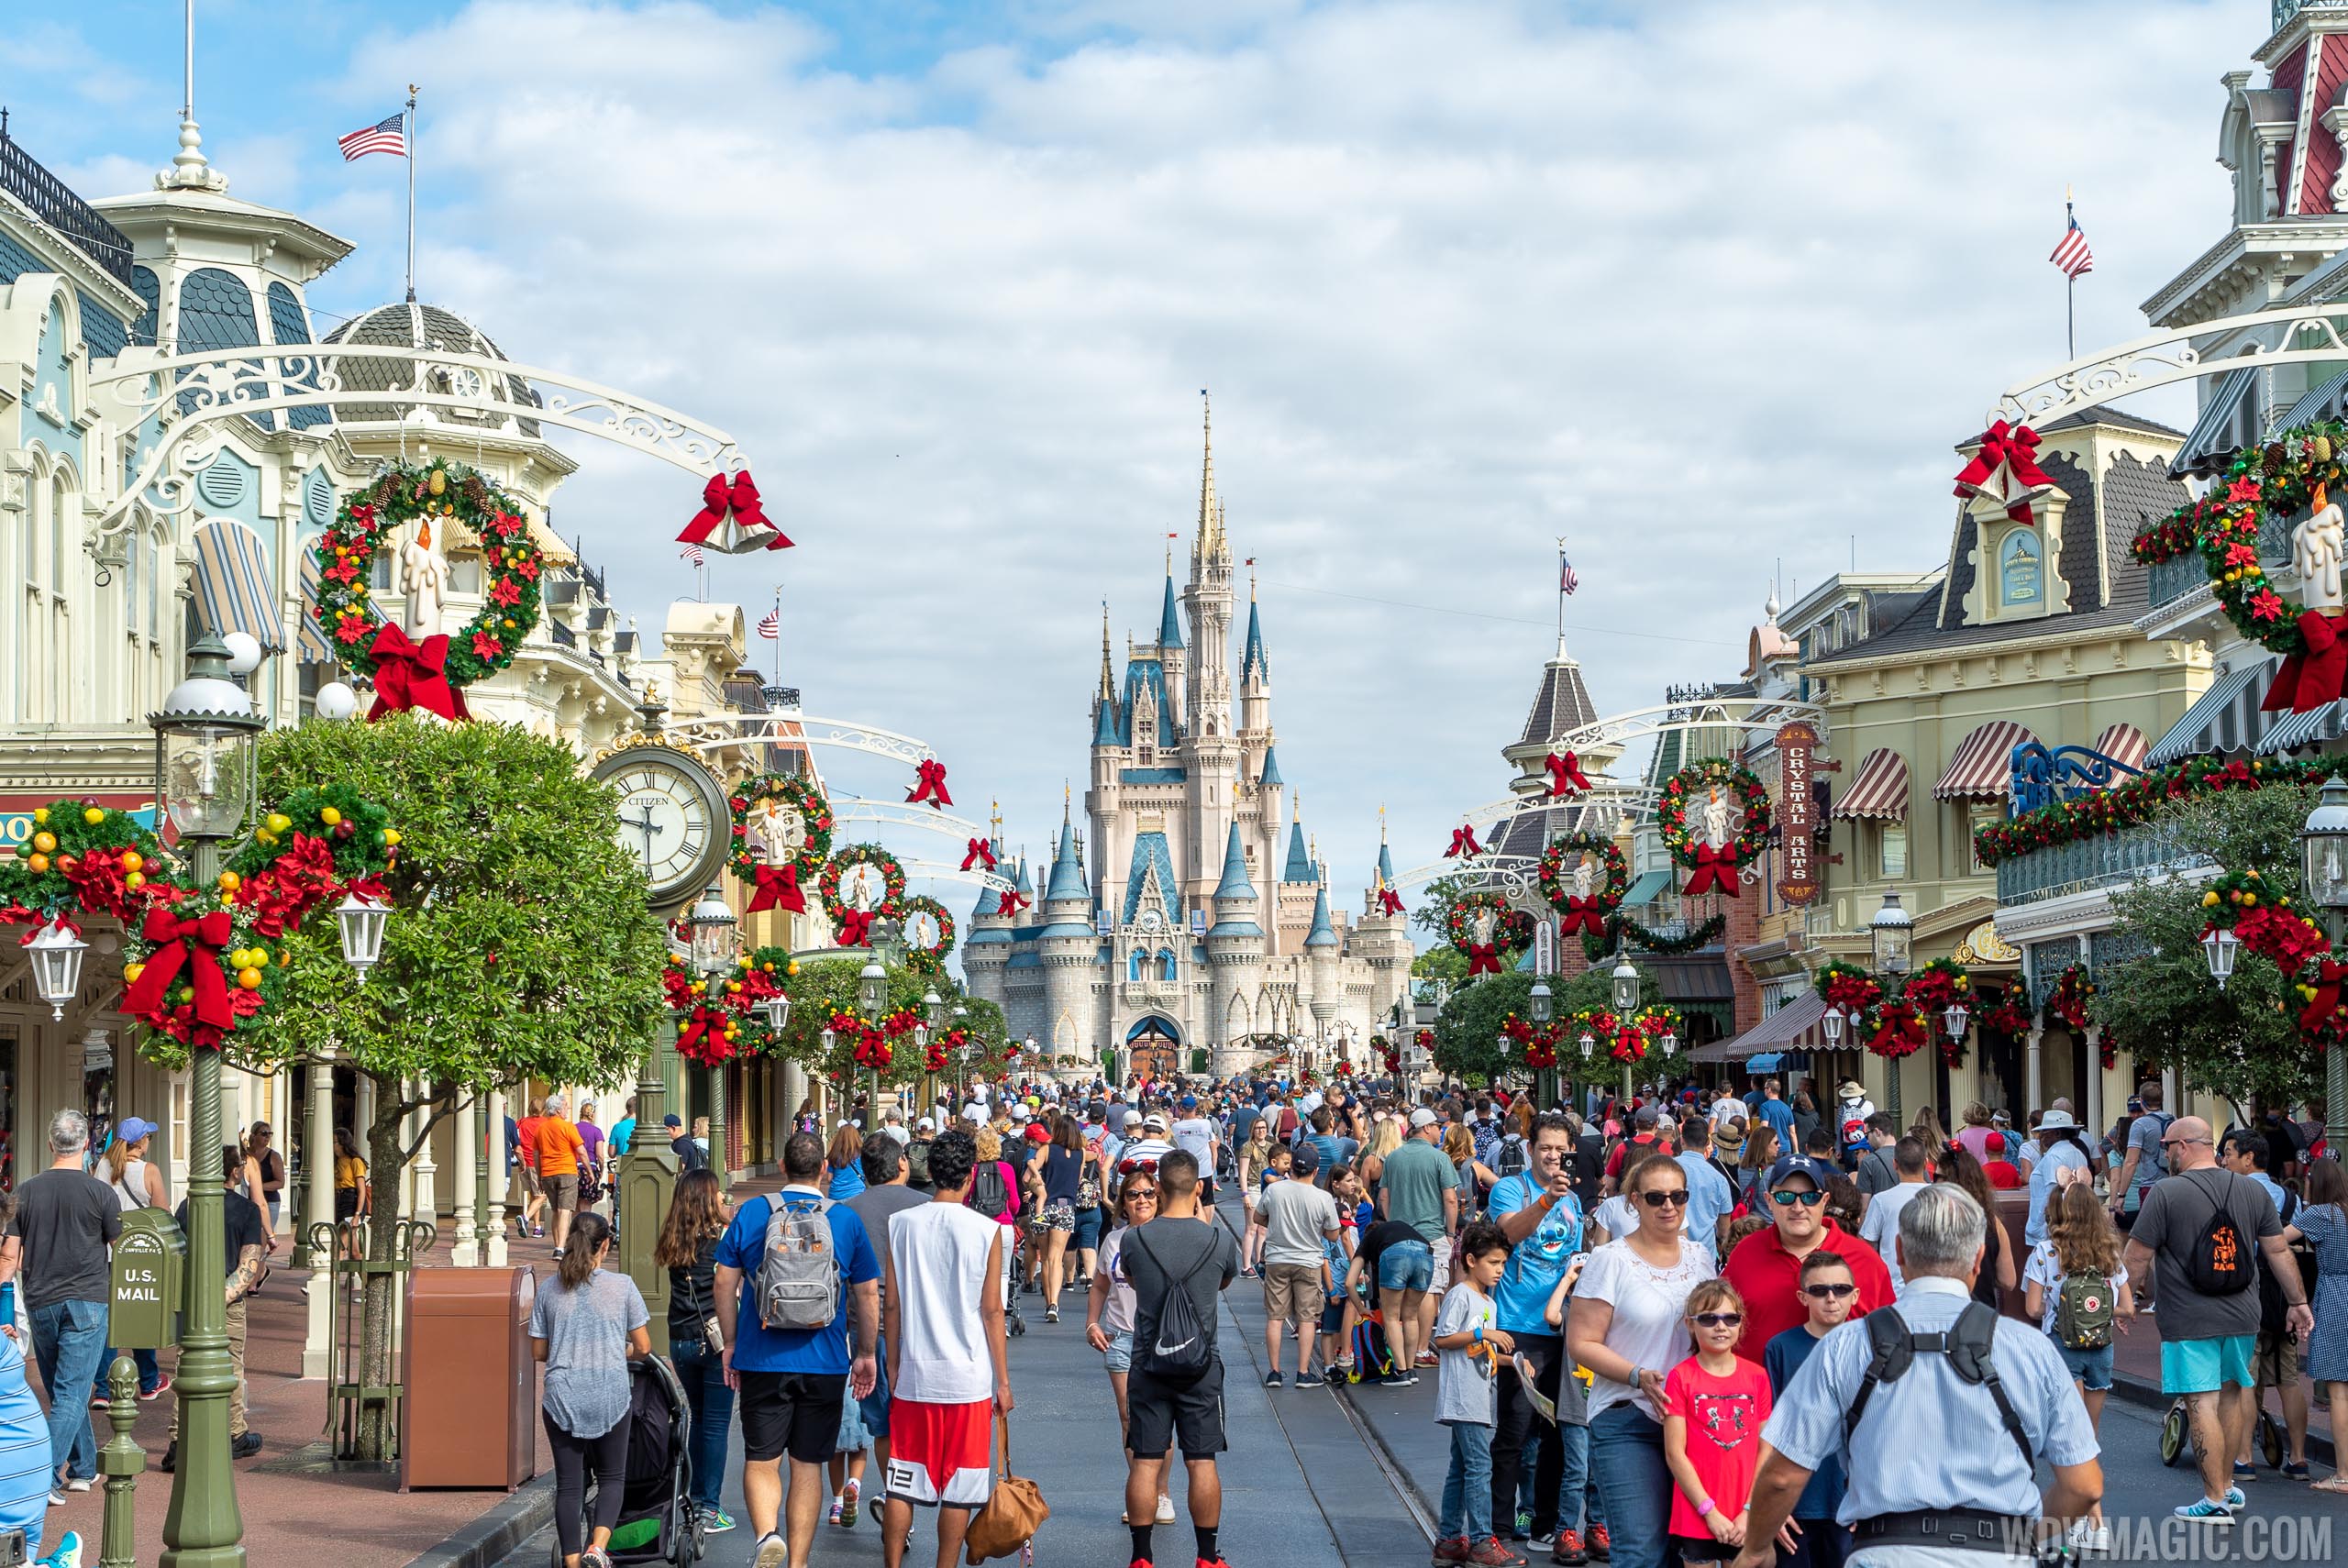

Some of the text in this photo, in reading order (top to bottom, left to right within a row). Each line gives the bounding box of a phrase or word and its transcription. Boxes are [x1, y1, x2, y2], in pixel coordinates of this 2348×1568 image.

[628, 797, 669, 806] CITIZEN
[1789, 747, 1807, 879] CRYSTAL ARTS
[125, 1268, 157, 1283] U.S.
[117, 1286, 160, 1301] MAIL
